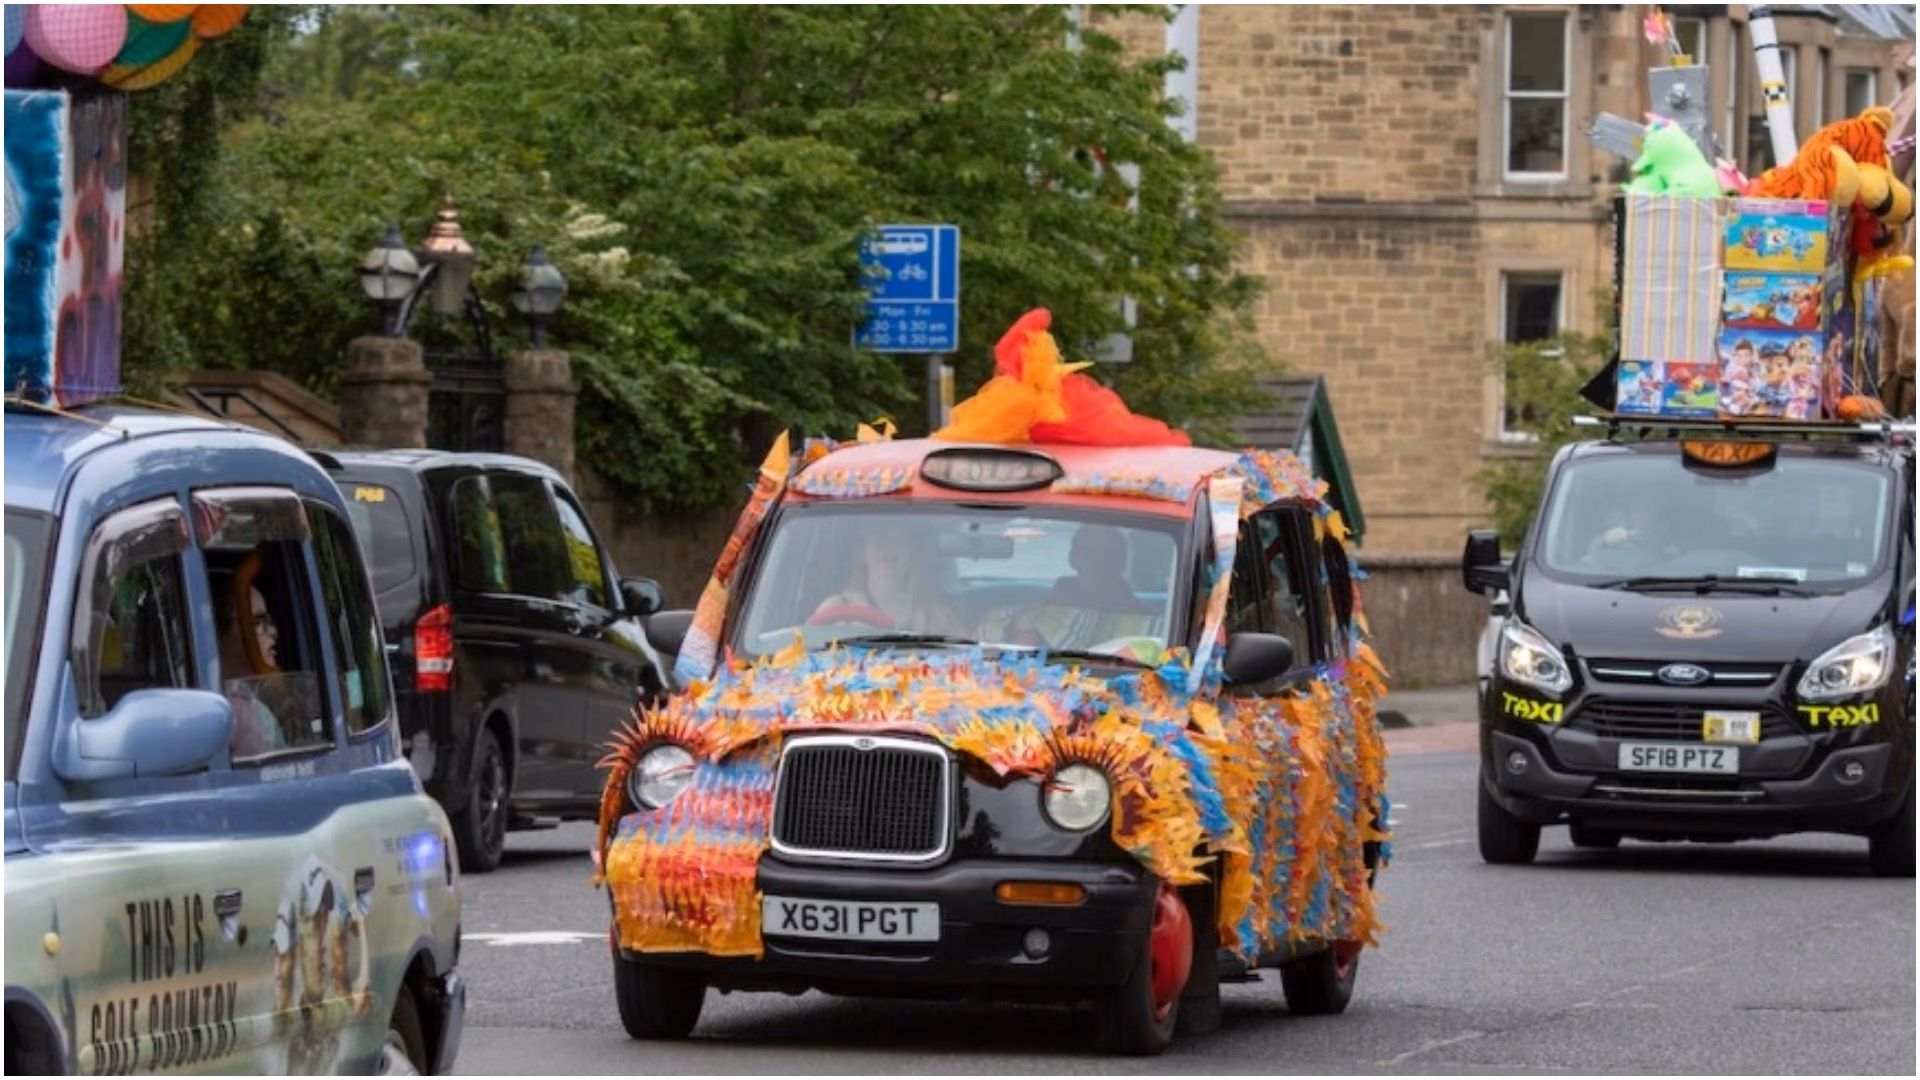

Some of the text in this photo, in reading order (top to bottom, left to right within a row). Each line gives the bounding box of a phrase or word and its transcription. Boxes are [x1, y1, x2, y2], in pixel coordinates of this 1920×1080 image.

[879, 305, 931, 317] Mon Fri
[1701, 442, 1752, 459] TAXI
[1502, 691, 1564, 723] TAXI
[1797, 702, 1880, 727] TAXI
[1632, 746, 1724, 769] SF18 PTZ
[781, 902, 919, 936] X631 PGT
[126, 893, 205, 983] THIS IS
[91, 981, 237, 1076] GOLF COUNTRY
